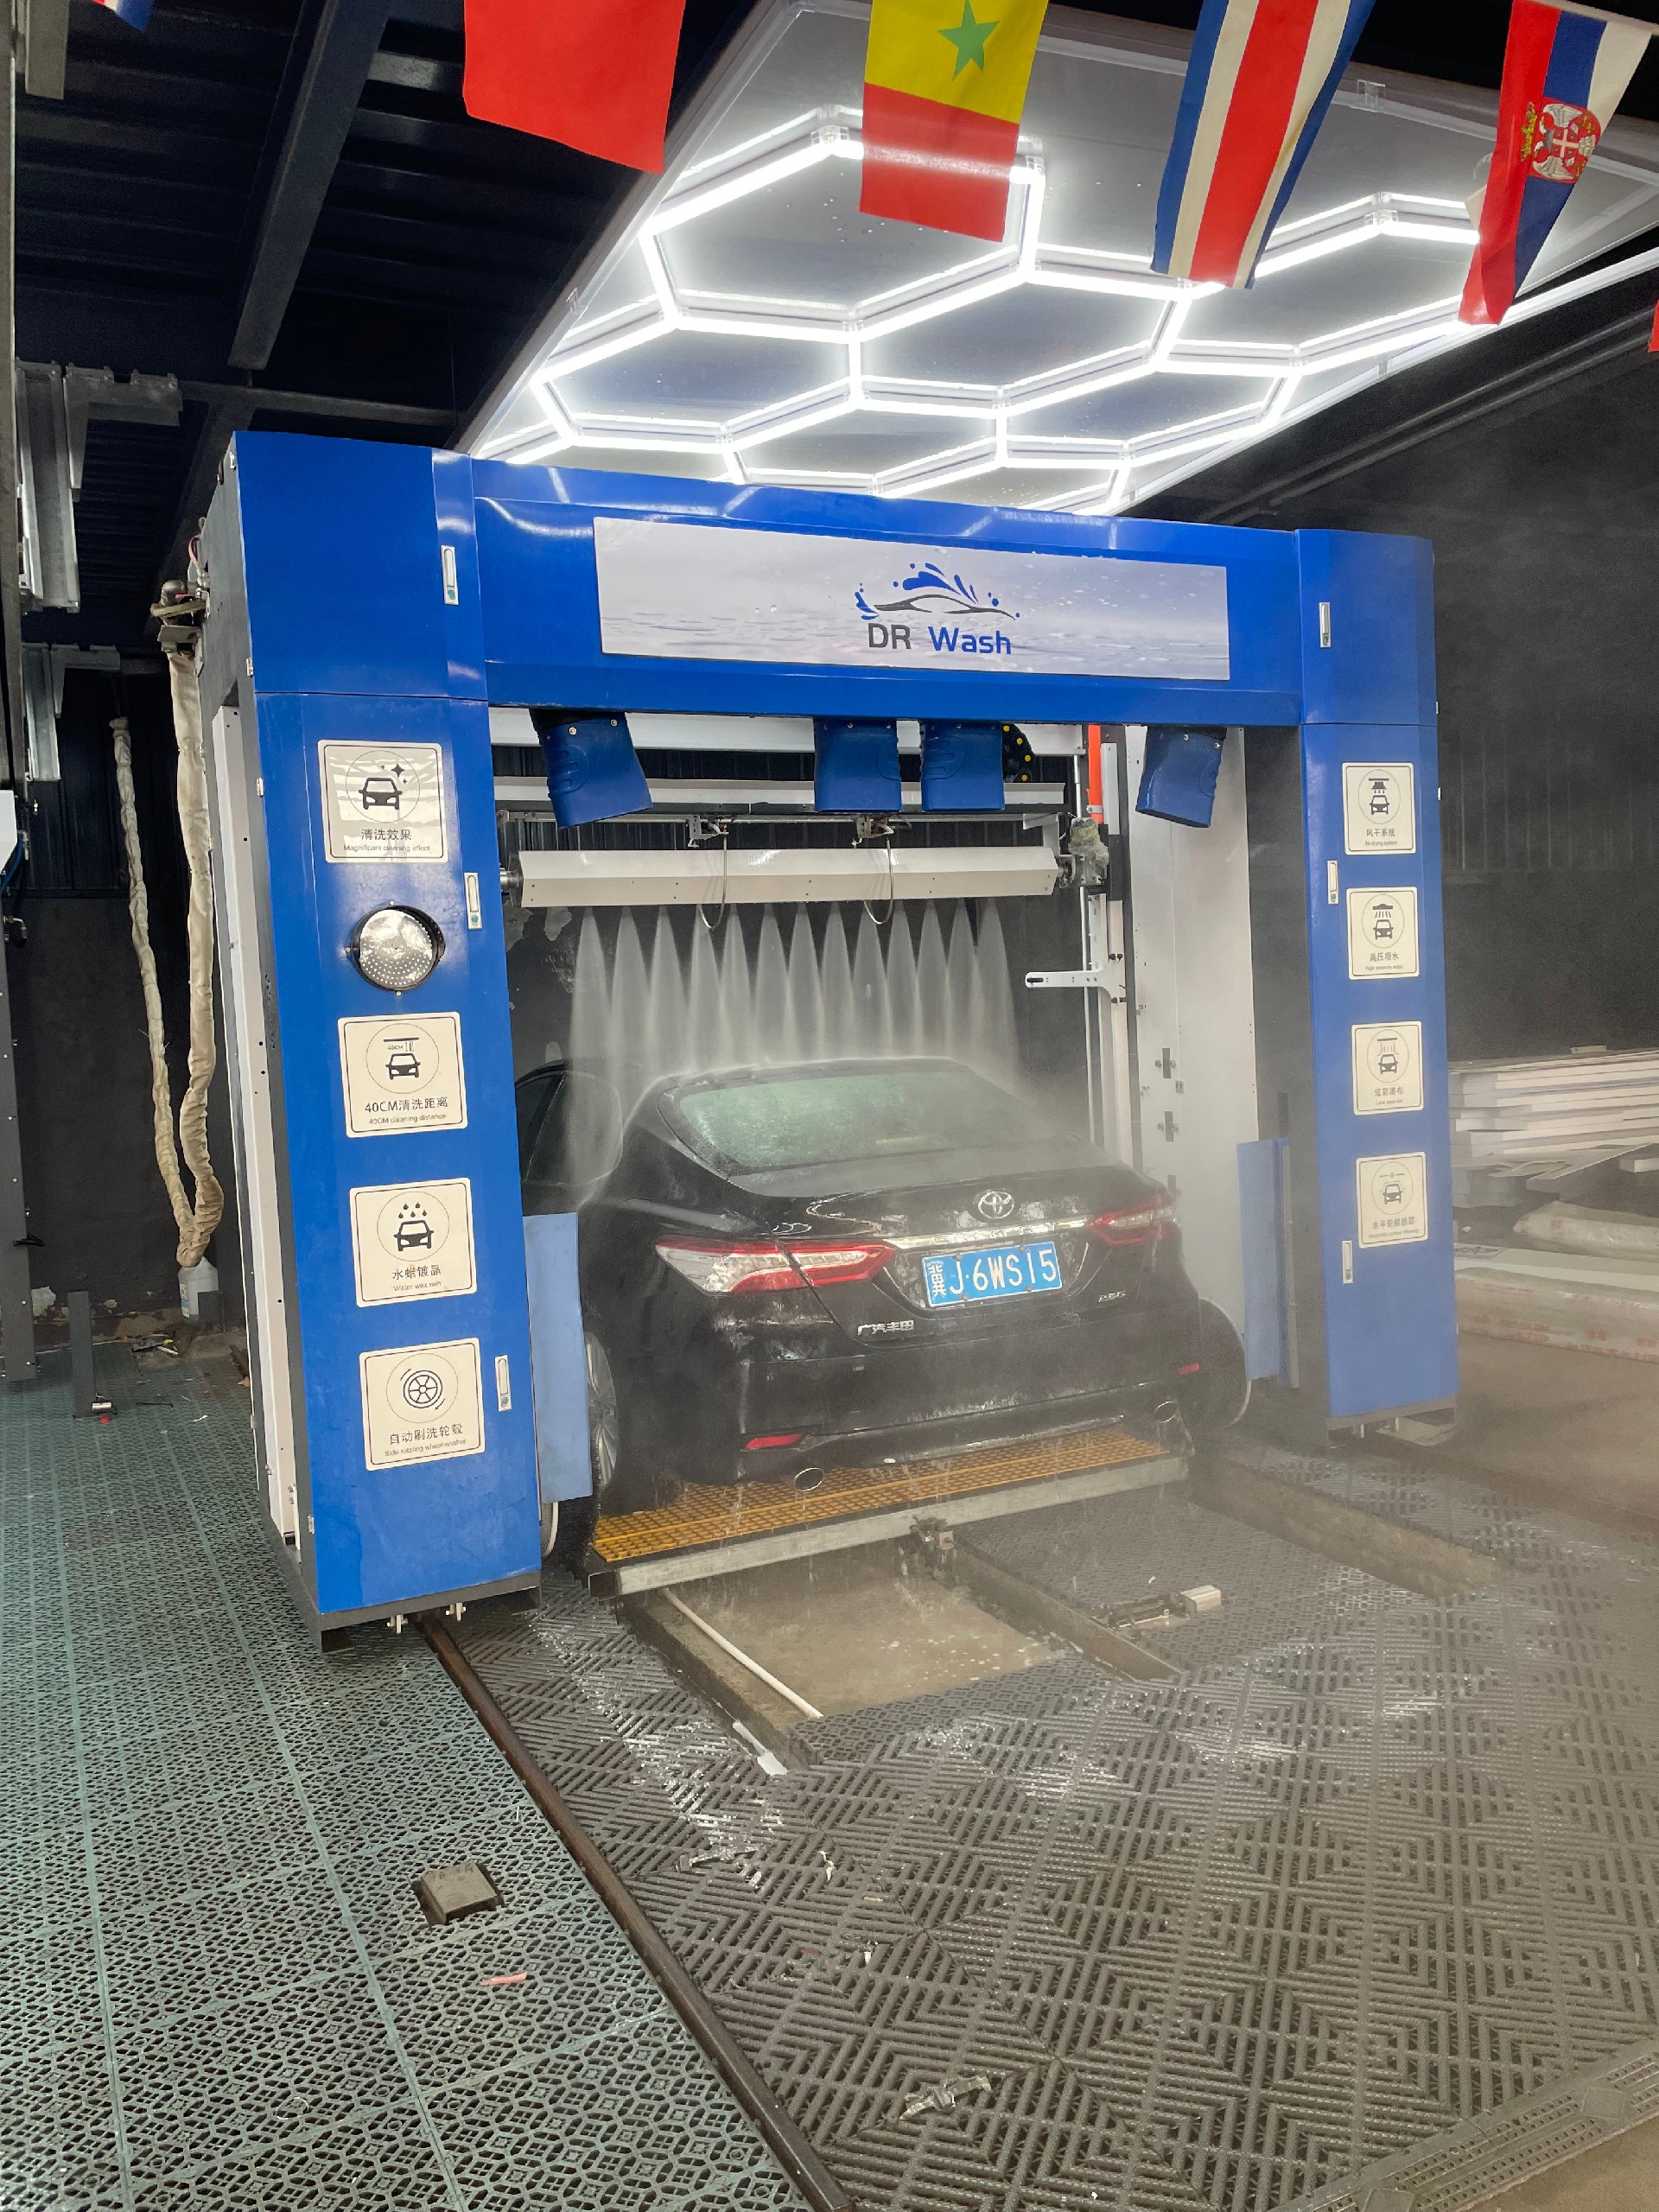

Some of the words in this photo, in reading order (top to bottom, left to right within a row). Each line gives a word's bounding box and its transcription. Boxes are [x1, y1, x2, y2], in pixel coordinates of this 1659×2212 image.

[868, 623, 912, 650] DR
[928, 626, 1012, 655] Wash
[361, 828, 412, 841] 清洗效果
[391, 1264, 442, 1281] 水蜡镀晶
[857, 1319, 914, 1336] 广汽丰田
